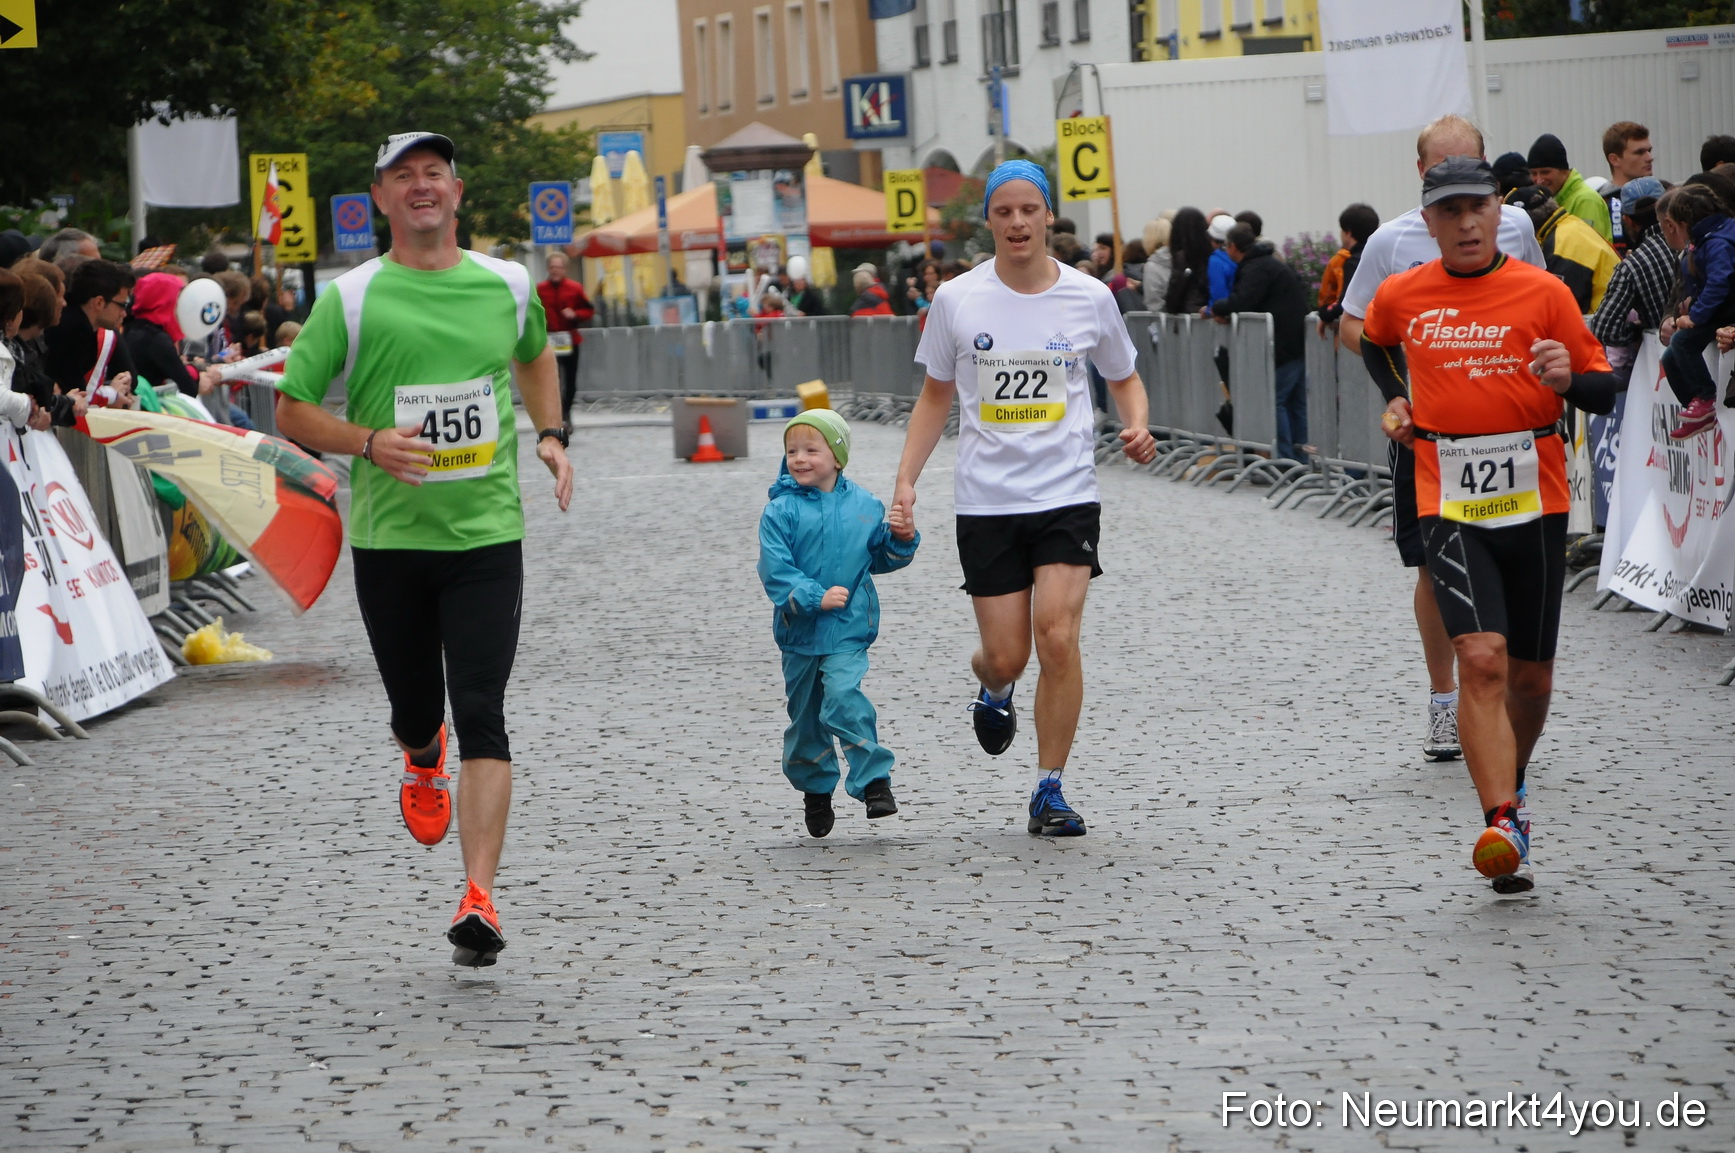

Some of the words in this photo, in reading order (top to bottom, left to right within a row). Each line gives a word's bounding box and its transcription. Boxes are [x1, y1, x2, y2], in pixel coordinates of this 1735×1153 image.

[851, 82, 901, 127] KL
[1062, 120, 1105, 136] Block
[1073, 141, 1100, 181] C
[889, 171, 922, 184] Block
[897, 188, 916, 217] D
[536, 225, 568, 239] TAXI
[338, 233, 370, 248] TAXI
[1422, 321, 1511, 340] Fischer
[1428, 340, 1503, 349] AUTOMOBILE
[979, 358, 1006, 367] PARTL
[1009, 358, 1050, 366] Neumarkt
[1465, 355, 1483, 366] das
[995, 370, 1048, 400] 222
[397, 395, 432, 405] PARTL
[435, 390, 481, 404] Neumarkt
[996, 408, 1047, 420] Christian
[420, 404, 482, 444] 456
[1440, 448, 1469, 458] PARTL
[1472, 443, 1518, 456] Neumarkt
[428, 452, 477, 468] Werner
[1461, 457, 1515, 494] 421
[1463, 498, 1518, 517] Friedrich
